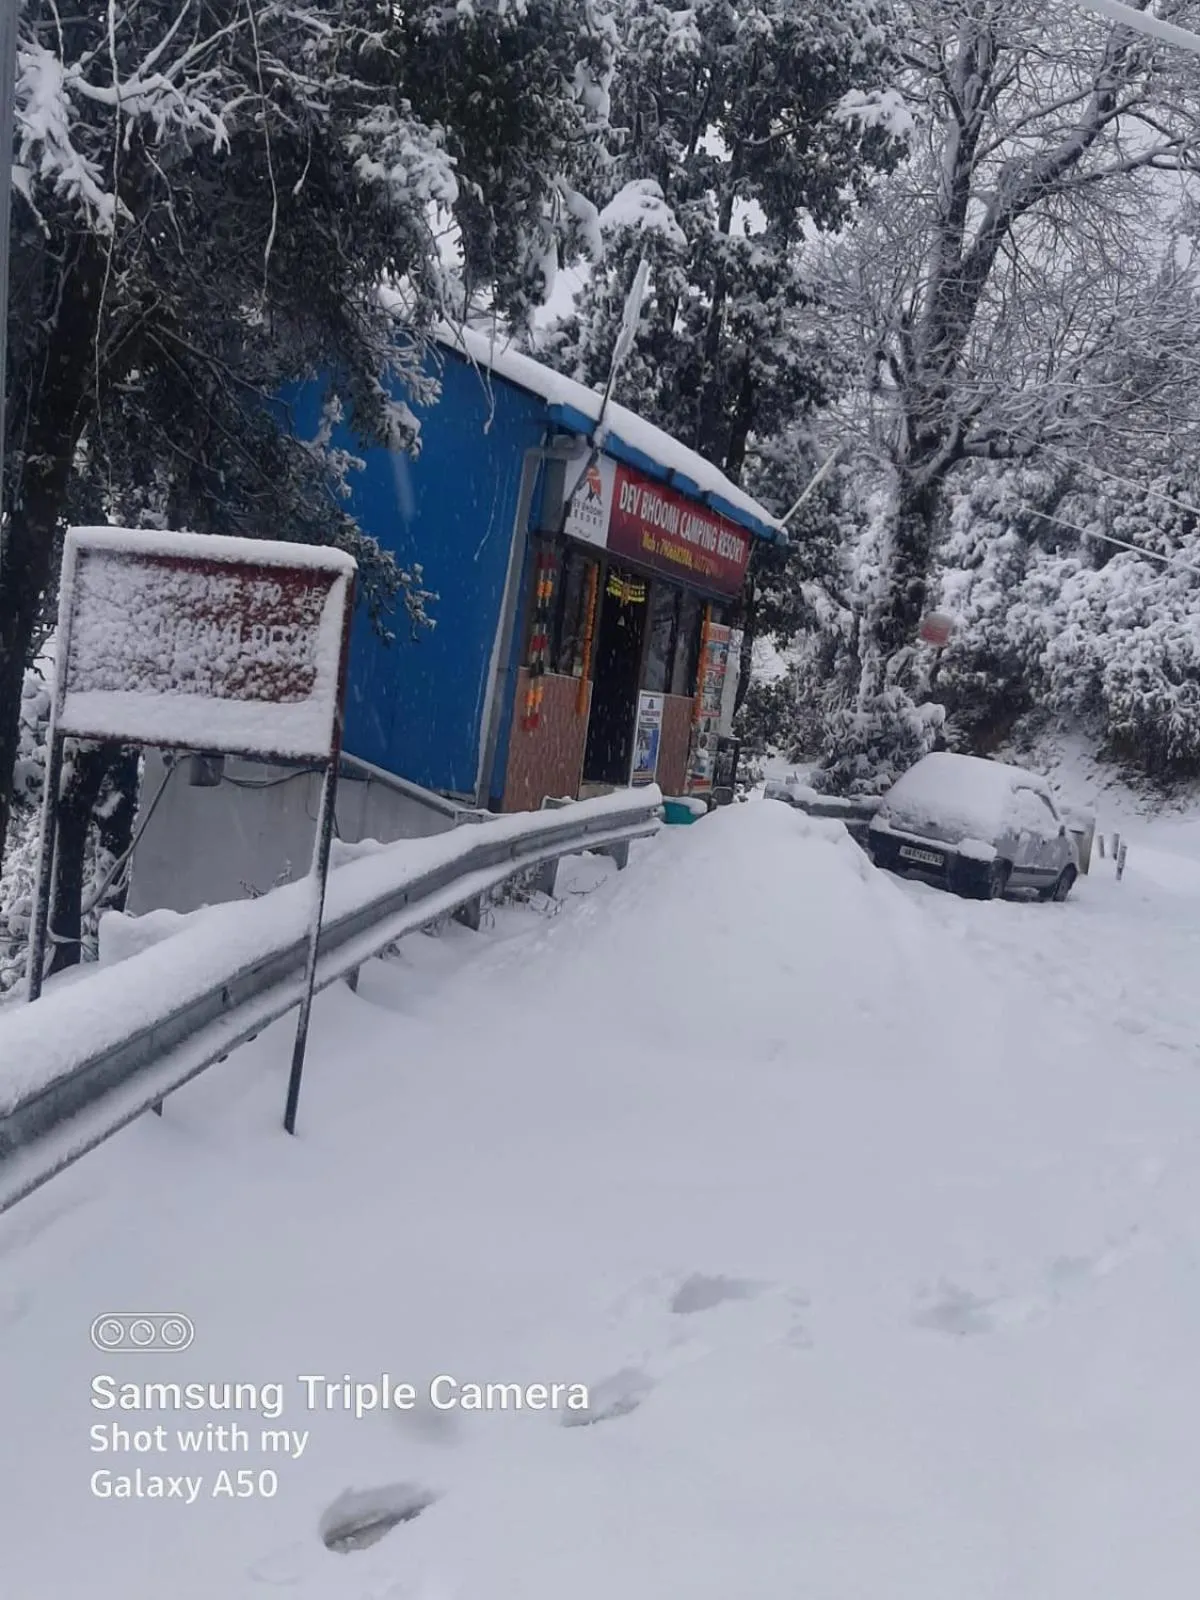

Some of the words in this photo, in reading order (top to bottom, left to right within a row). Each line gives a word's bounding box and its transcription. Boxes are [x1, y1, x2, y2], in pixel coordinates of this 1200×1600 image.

[619, 481, 640, 515] DEV
[641, 492, 680, 535] BHOOMI
[680, 510, 718, 551] CAMPING
[718, 529, 746, 565] RESORT
